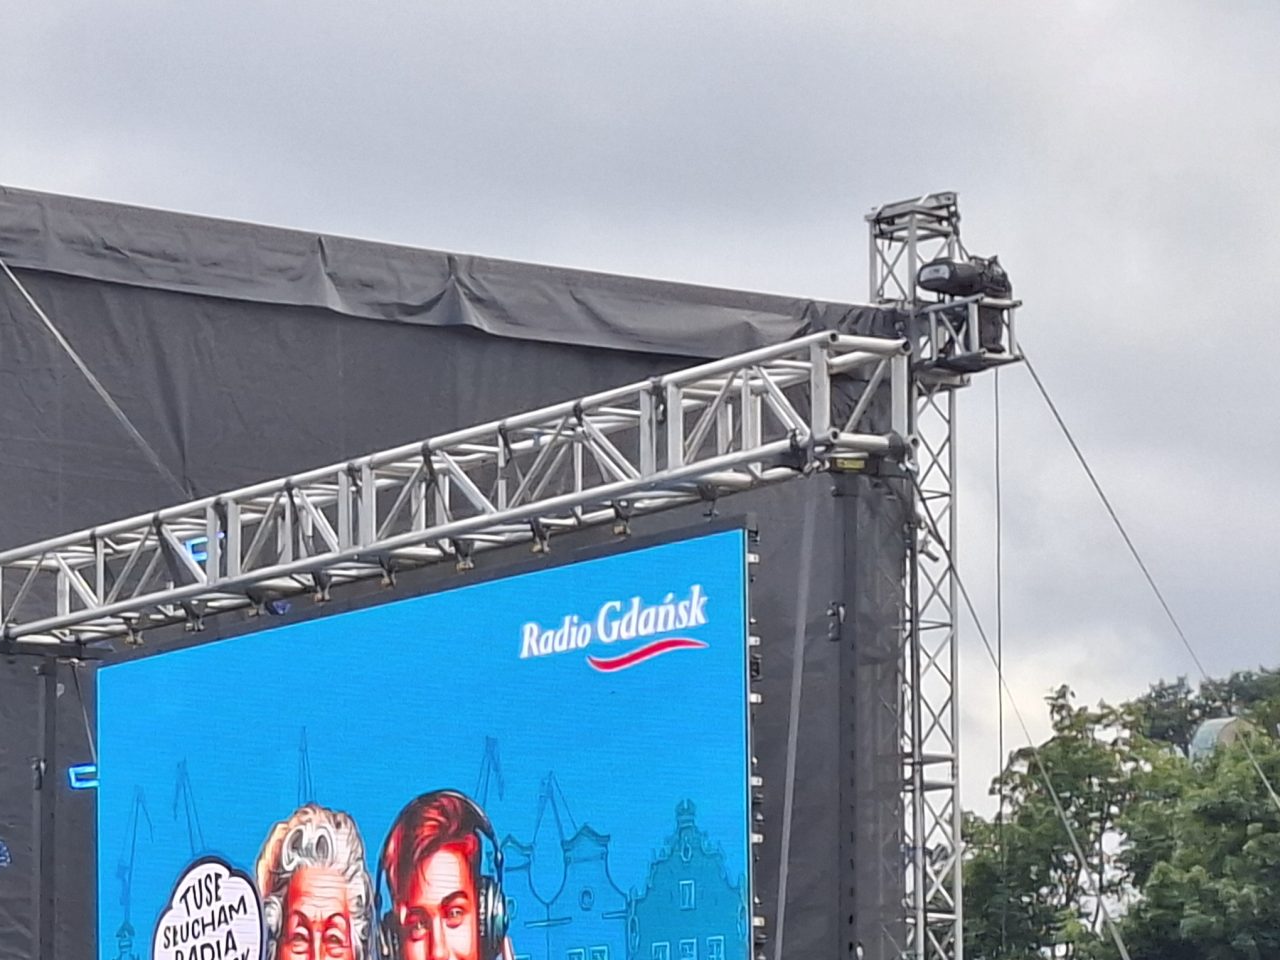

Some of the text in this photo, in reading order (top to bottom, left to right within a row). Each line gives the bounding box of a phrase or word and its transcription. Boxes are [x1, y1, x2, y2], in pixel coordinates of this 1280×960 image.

[520, 584, 708, 659] Radio Gdańsk
[163, 895, 248, 949] SŁUCHAM
